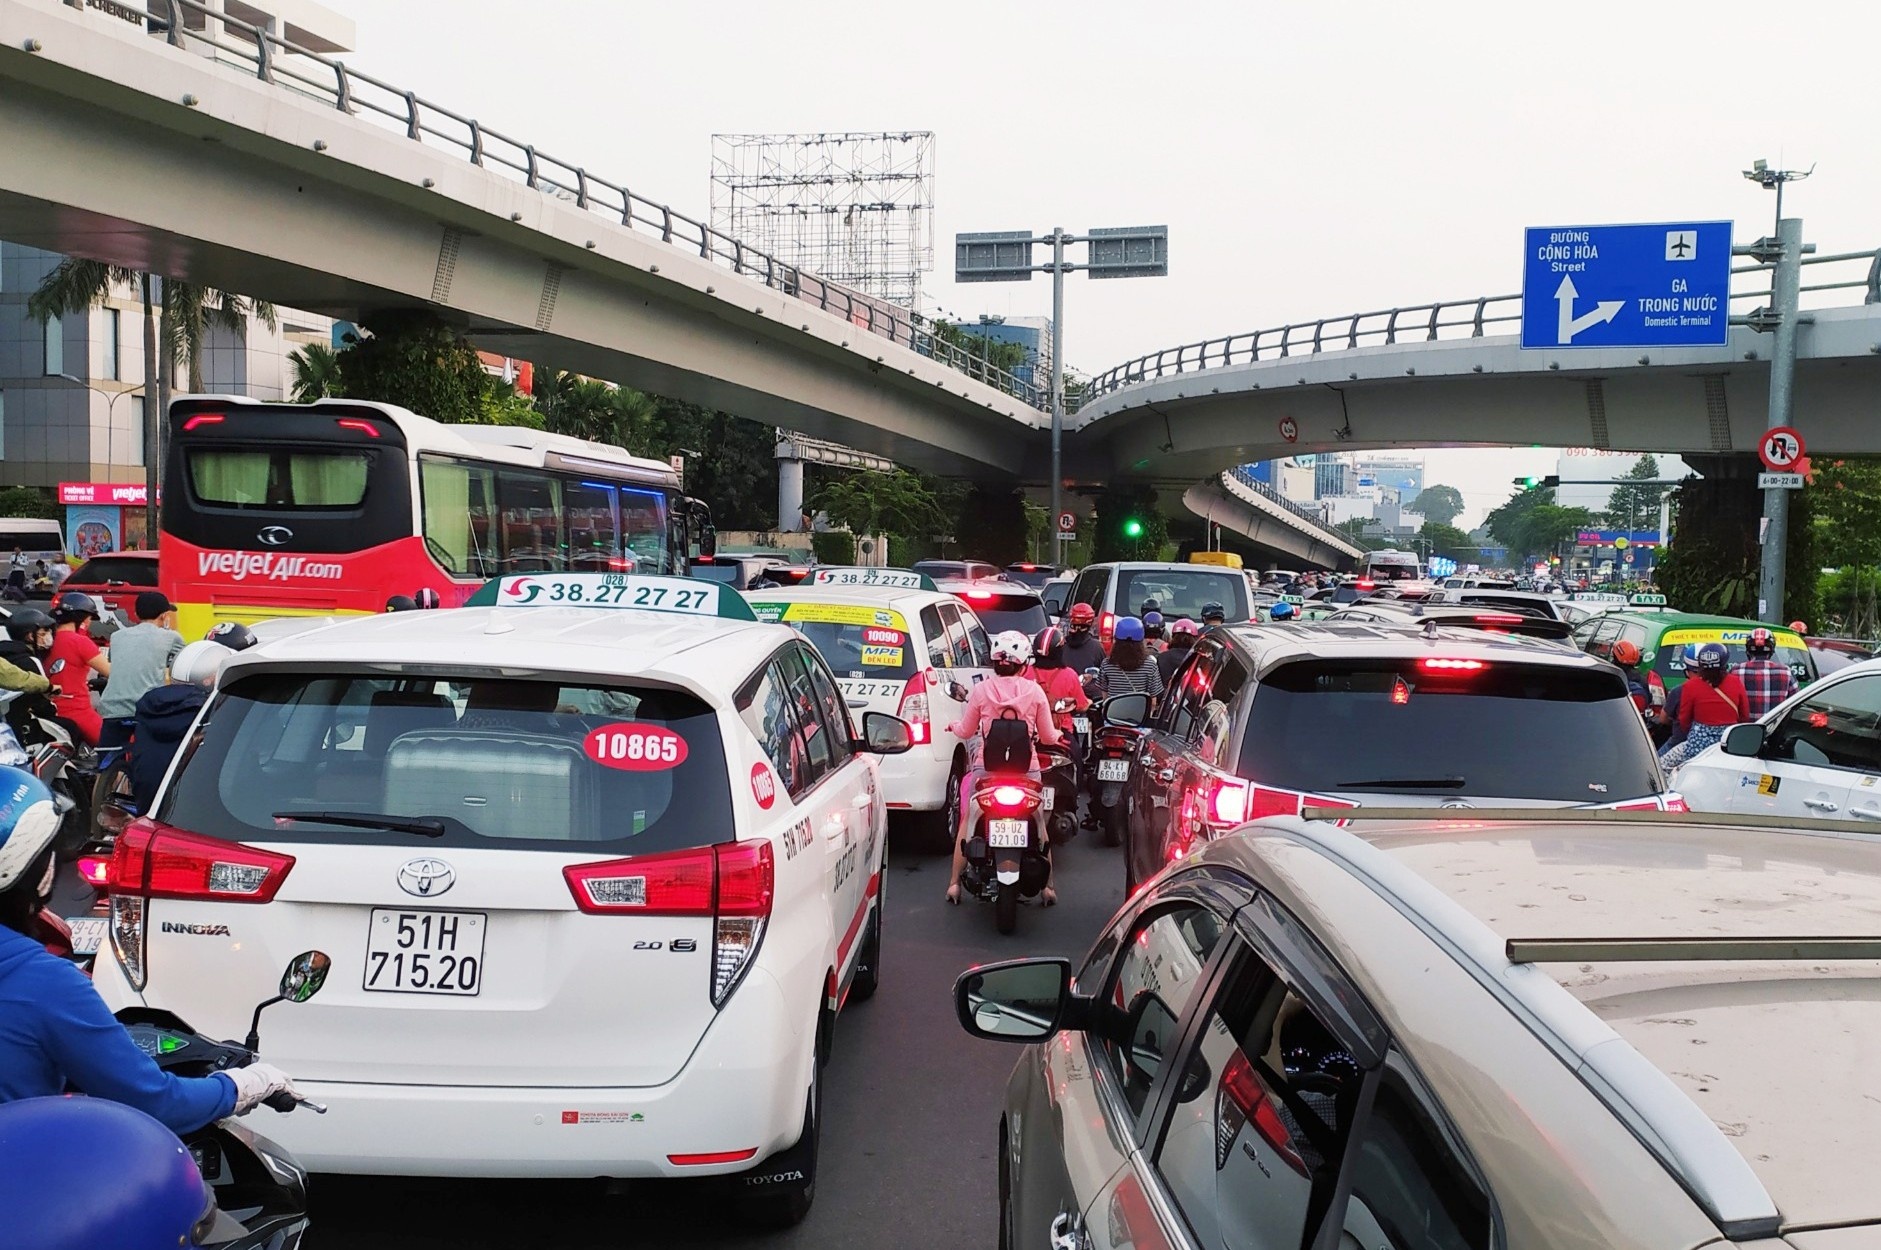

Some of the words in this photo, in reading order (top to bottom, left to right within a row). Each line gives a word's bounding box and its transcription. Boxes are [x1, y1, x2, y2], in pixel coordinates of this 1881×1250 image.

[1550, 230, 1589, 243] ĐƯỜNG
[1539, 244, 1571, 262] CỘNG
[1574, 242, 1598, 259] HÒA
[1551, 262, 1586, 272] Street
[1672, 278, 1688, 293] GA
[1638, 298, 1679, 312] TRONG
[1683, 293, 1718, 312] NƯỚC
[1645, 316, 1678, 327] Domestic
[1680, 315, 1711, 326] Terminal
[602, 574, 629, 586] (028)
[841, 574, 879, 584] 38.27
[882, 575, 899, 585] 27
[902, 576, 919, 586] 27
[549, 582, 628, 604] 38.27
[633, 586, 668, 606] 27
[674, 590, 709, 609] 27
[867, 630, 899, 643] 10090
[864, 647, 900, 656] MPE
[883, 657, 897, 665] LED
[857, 684, 876, 695] 27
[881, 685, 900, 696] 27
[594, 733, 678, 762] 10865
[995, 823, 1022, 833] 59-U2
[991, 835, 1026, 845] 321.09
[162, 921, 231, 936] INNOVA
[397, 914, 459, 951] 51H
[368, 950, 478, 991] 715.20
[744, 1170, 804, 1185] TOYOTA
